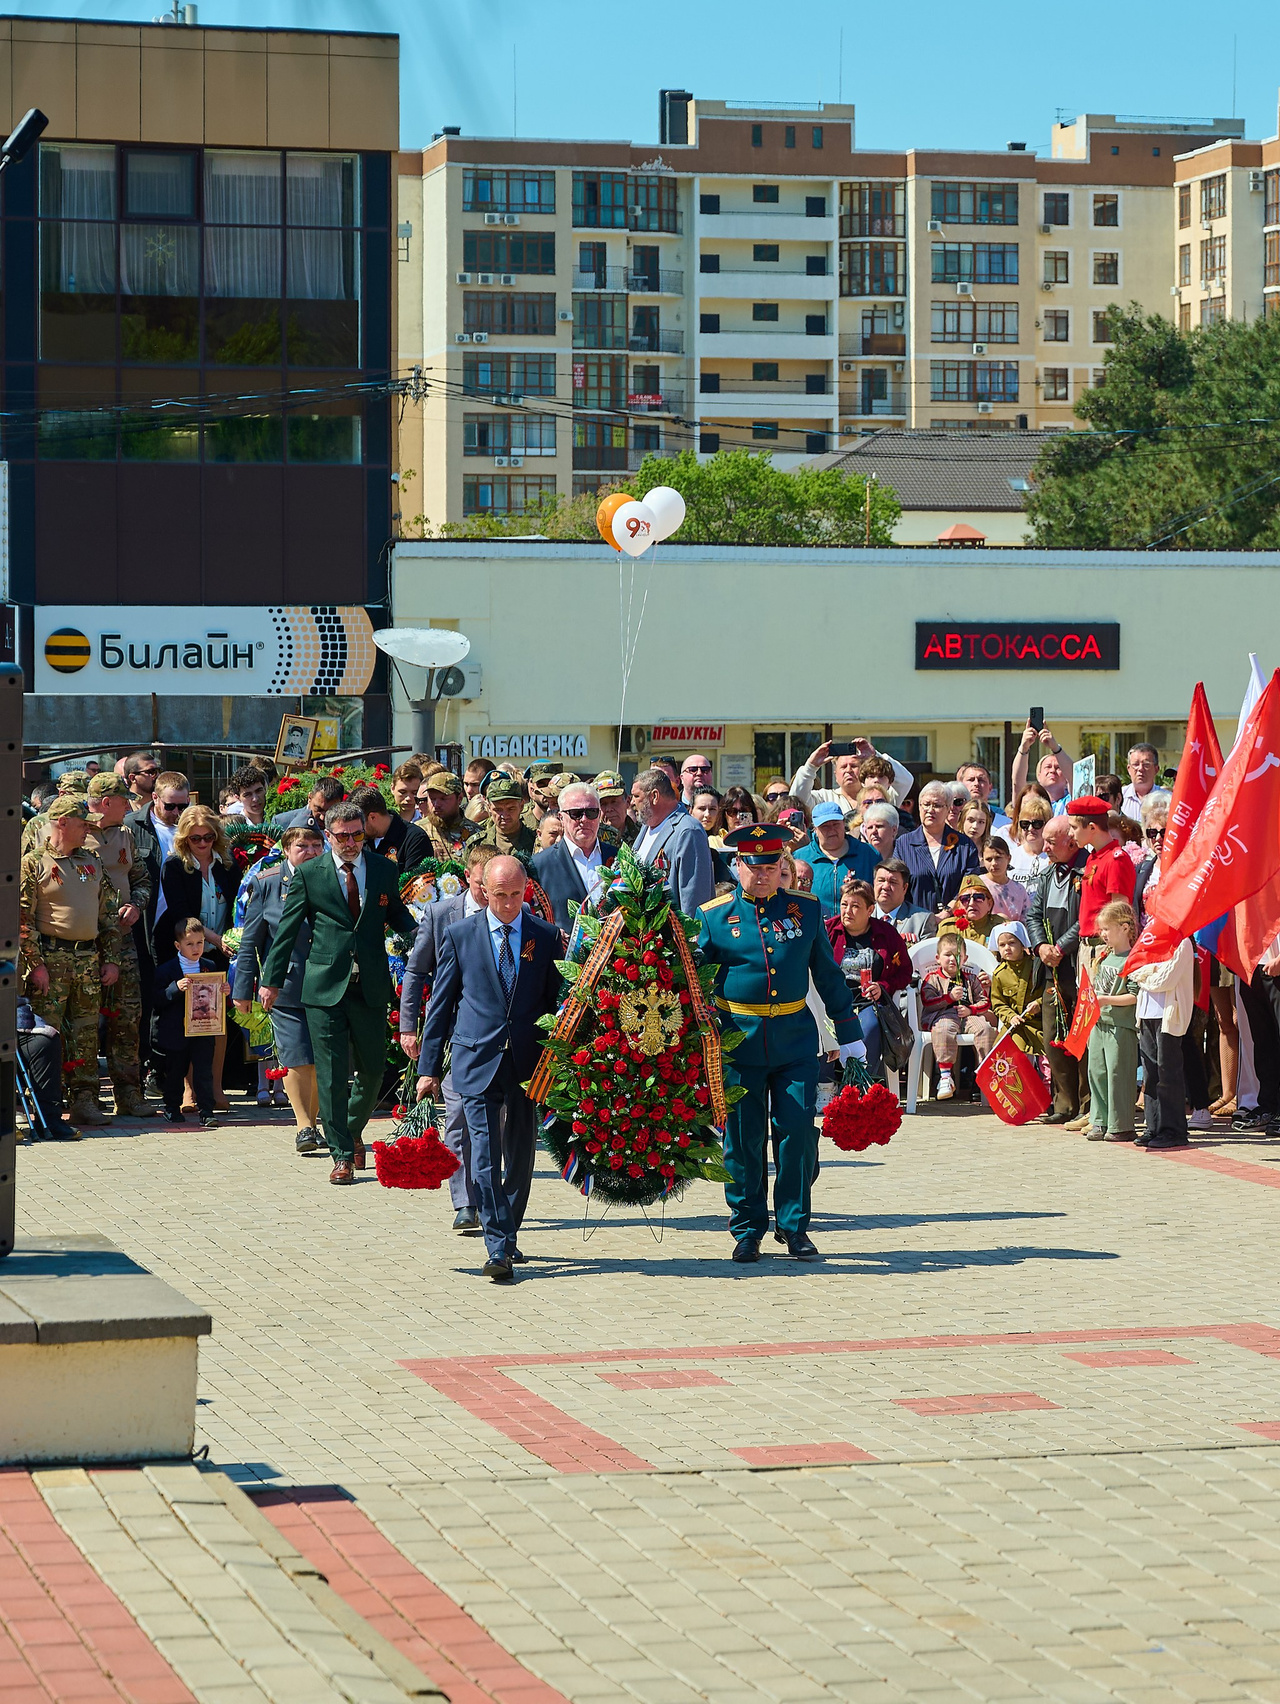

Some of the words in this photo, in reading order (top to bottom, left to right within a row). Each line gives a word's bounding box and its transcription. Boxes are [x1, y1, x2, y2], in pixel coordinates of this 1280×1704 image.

[626, 518, 640, 538] 9
[924, 633, 1101, 660] АВТОКАССА
[652, 726, 723, 741] ПРОДУКТЫ
[469, 735, 588, 758] ТАБАКЕРКА
